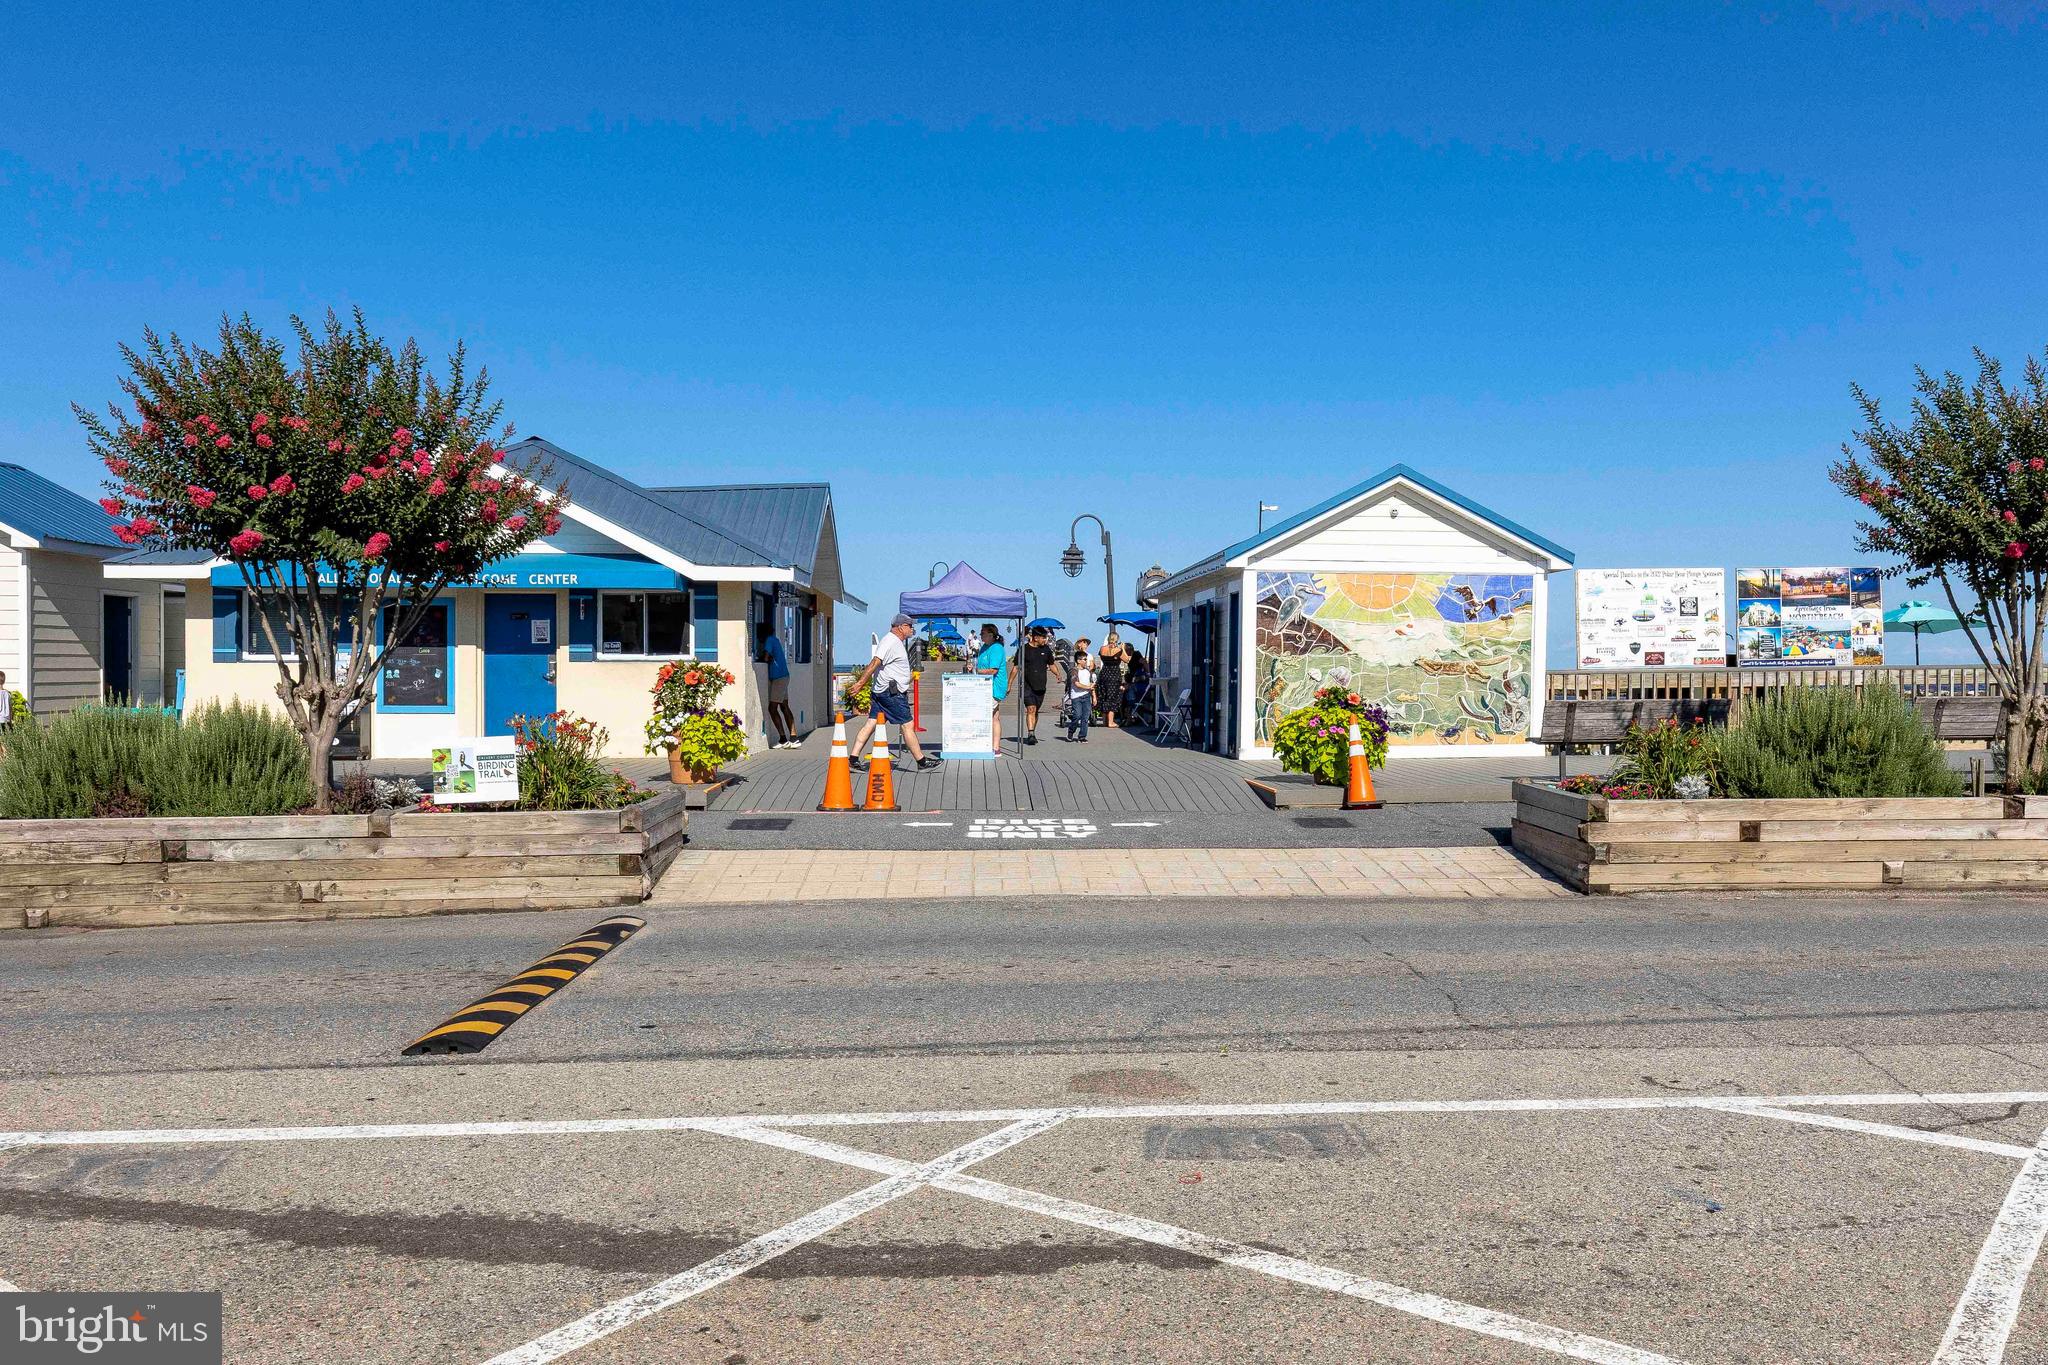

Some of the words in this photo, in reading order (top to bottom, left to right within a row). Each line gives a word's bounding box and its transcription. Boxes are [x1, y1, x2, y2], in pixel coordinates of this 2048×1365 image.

[1702, 570, 1723, 578] Sponsors
[529, 573, 579, 585] CENTER
[478, 761, 515, 770] BIRDING
[478, 769, 504, 778] TRAIL
